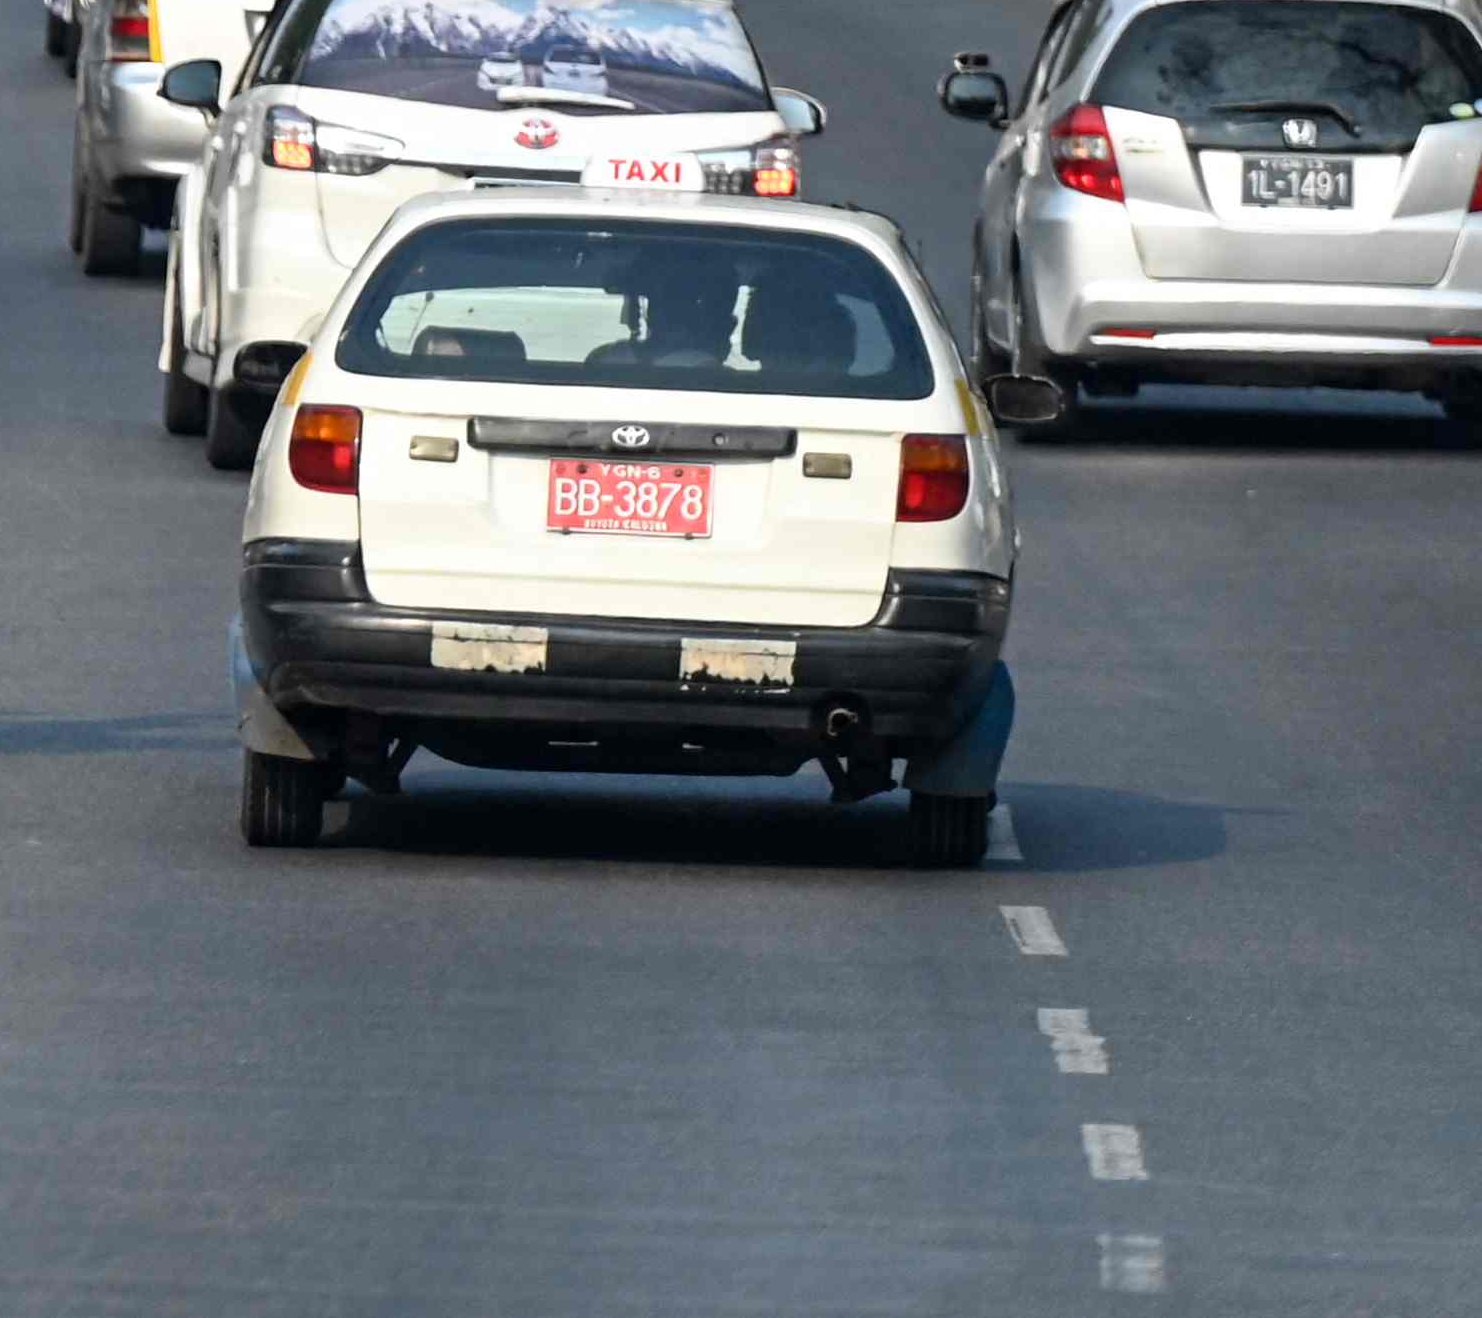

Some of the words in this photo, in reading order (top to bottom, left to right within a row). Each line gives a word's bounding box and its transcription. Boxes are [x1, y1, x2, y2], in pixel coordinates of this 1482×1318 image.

[607, 159, 682, 183] TAXI
[1247, 169, 1348, 200] 1L-1491
[601, 465, 662, 480] YGN-6
[554, 477, 704, 520] BB-3878
